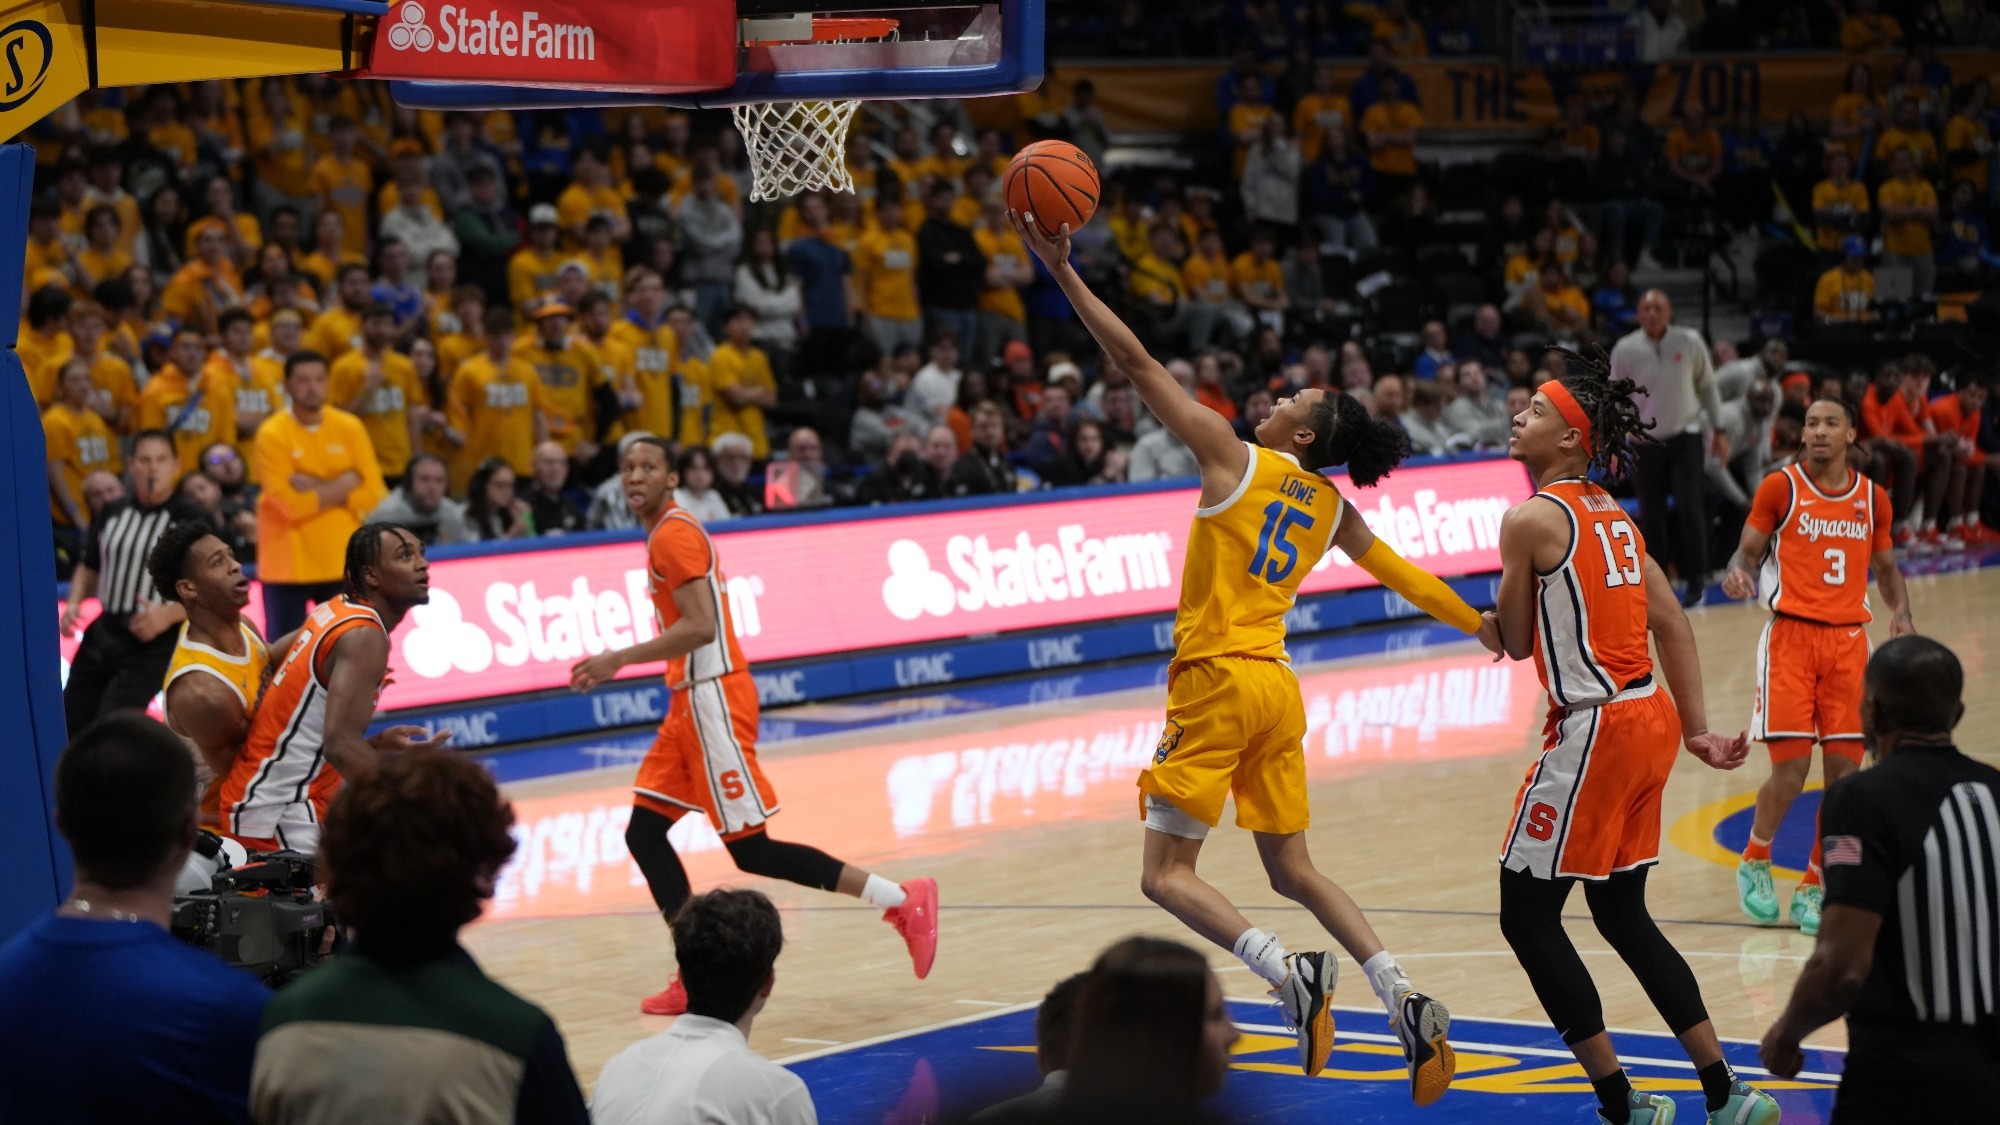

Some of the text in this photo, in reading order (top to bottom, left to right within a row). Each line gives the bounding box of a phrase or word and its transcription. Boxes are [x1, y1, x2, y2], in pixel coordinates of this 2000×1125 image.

[1446, 69, 1529, 121] THE
[1279, 474, 1317, 507] LOWE
[1247, 499, 1316, 585] 15
[1797, 511, 1869, 543] Syracuse
[1593, 518, 1643, 589] 13
[1822, 547, 1847, 587] 3
[894, 652, 955, 688] UPMC
[1027, 634, 1083, 670] UPMC
[592, 687, 662, 727] UPMC
[754, 670, 807, 707] PMC
[719, 768, 746, 801] S
[1525, 801, 1559, 842] S
